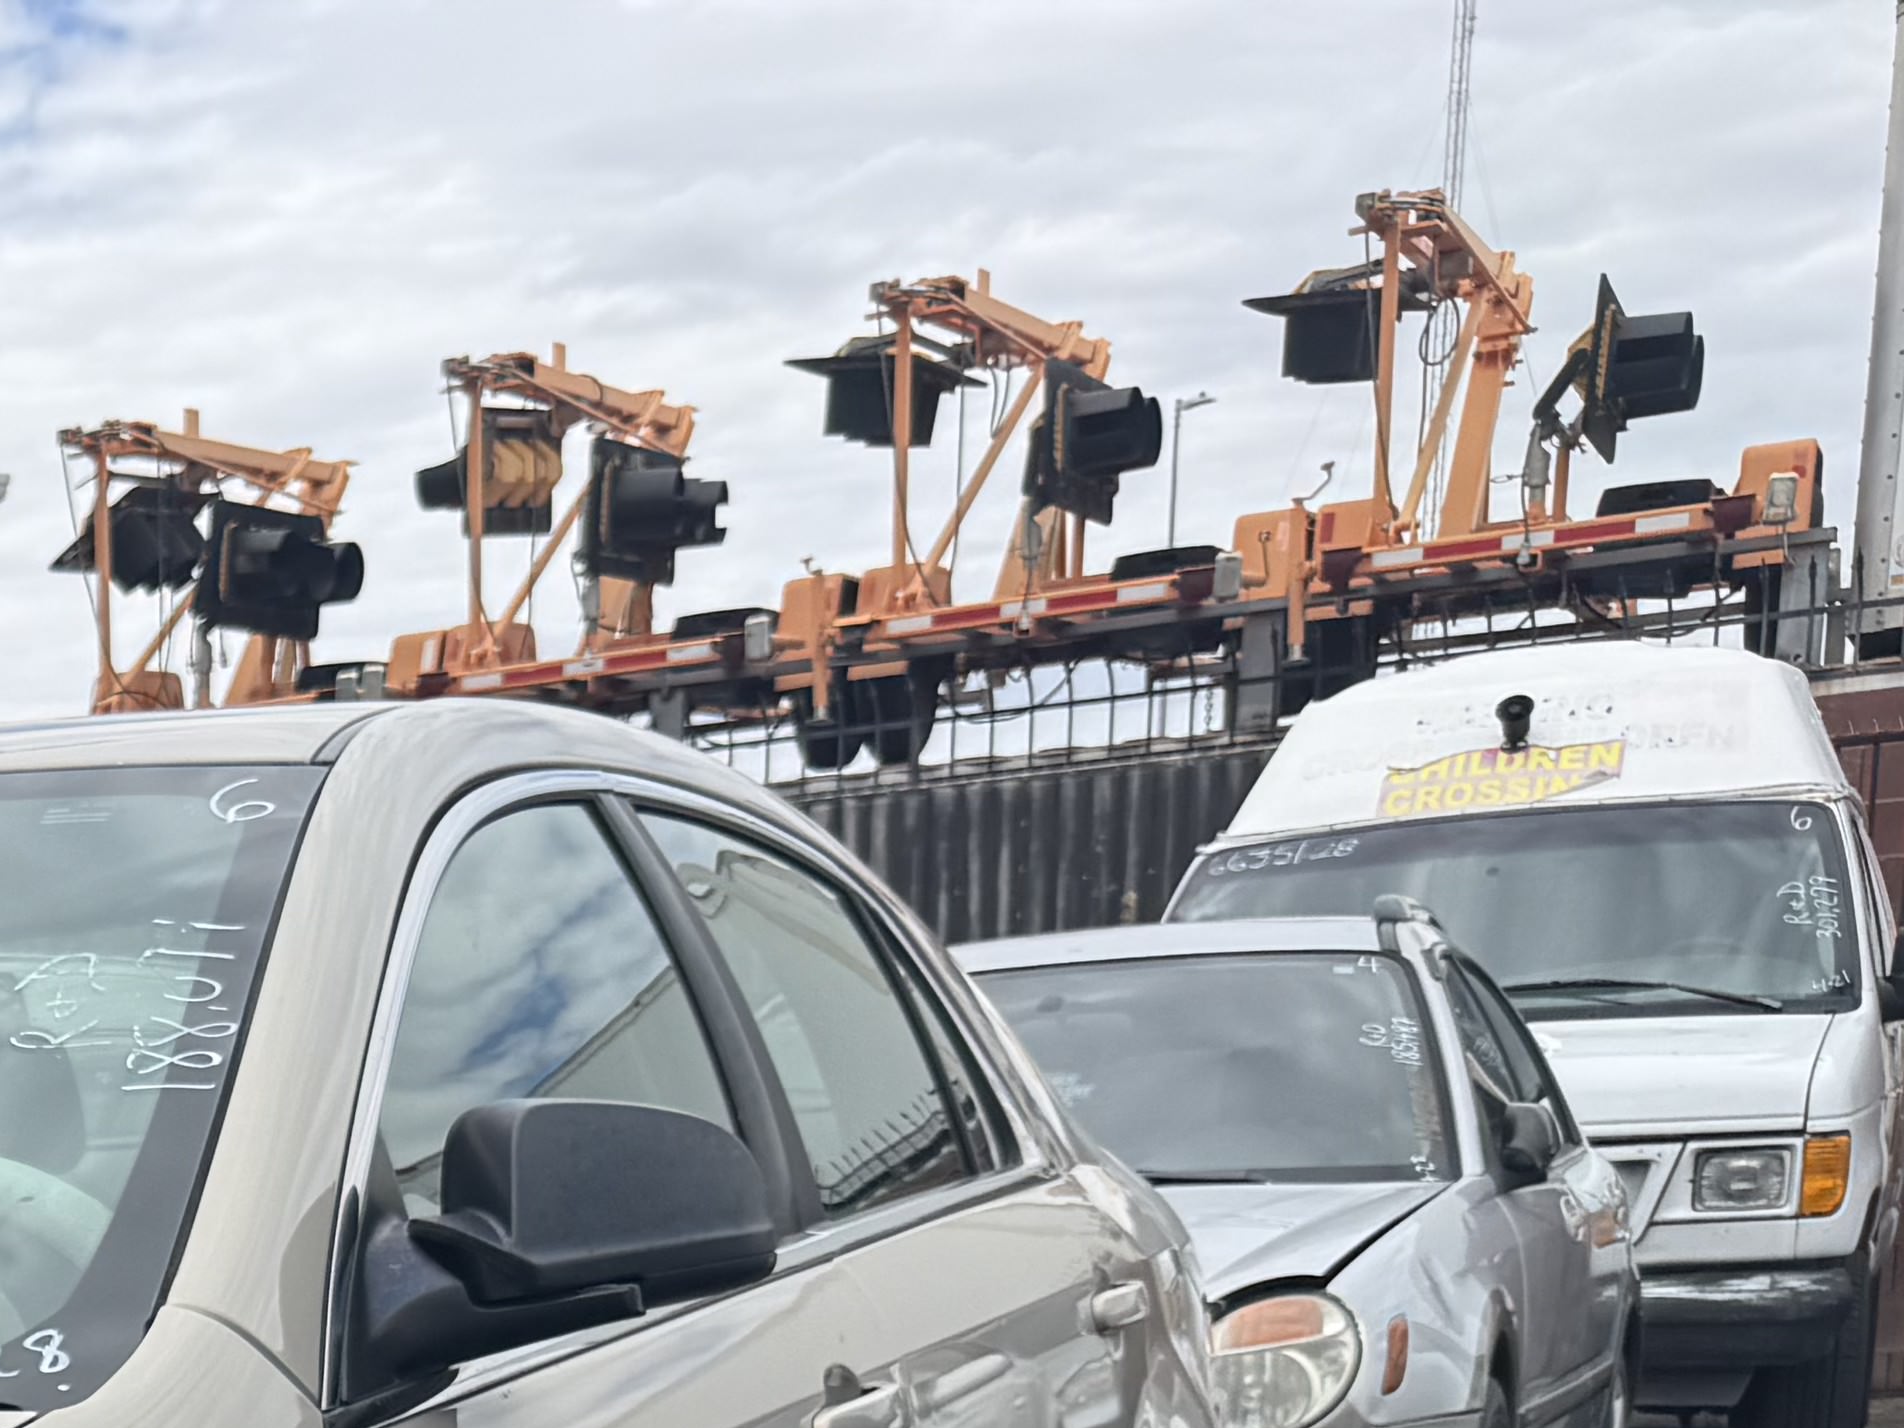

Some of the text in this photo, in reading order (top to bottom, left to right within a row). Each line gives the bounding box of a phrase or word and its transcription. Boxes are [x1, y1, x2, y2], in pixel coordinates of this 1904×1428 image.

[210, 778, 276, 823] 6
[1791, 805, 1813, 831] 6
[1358, 957, 1382, 974] 4
